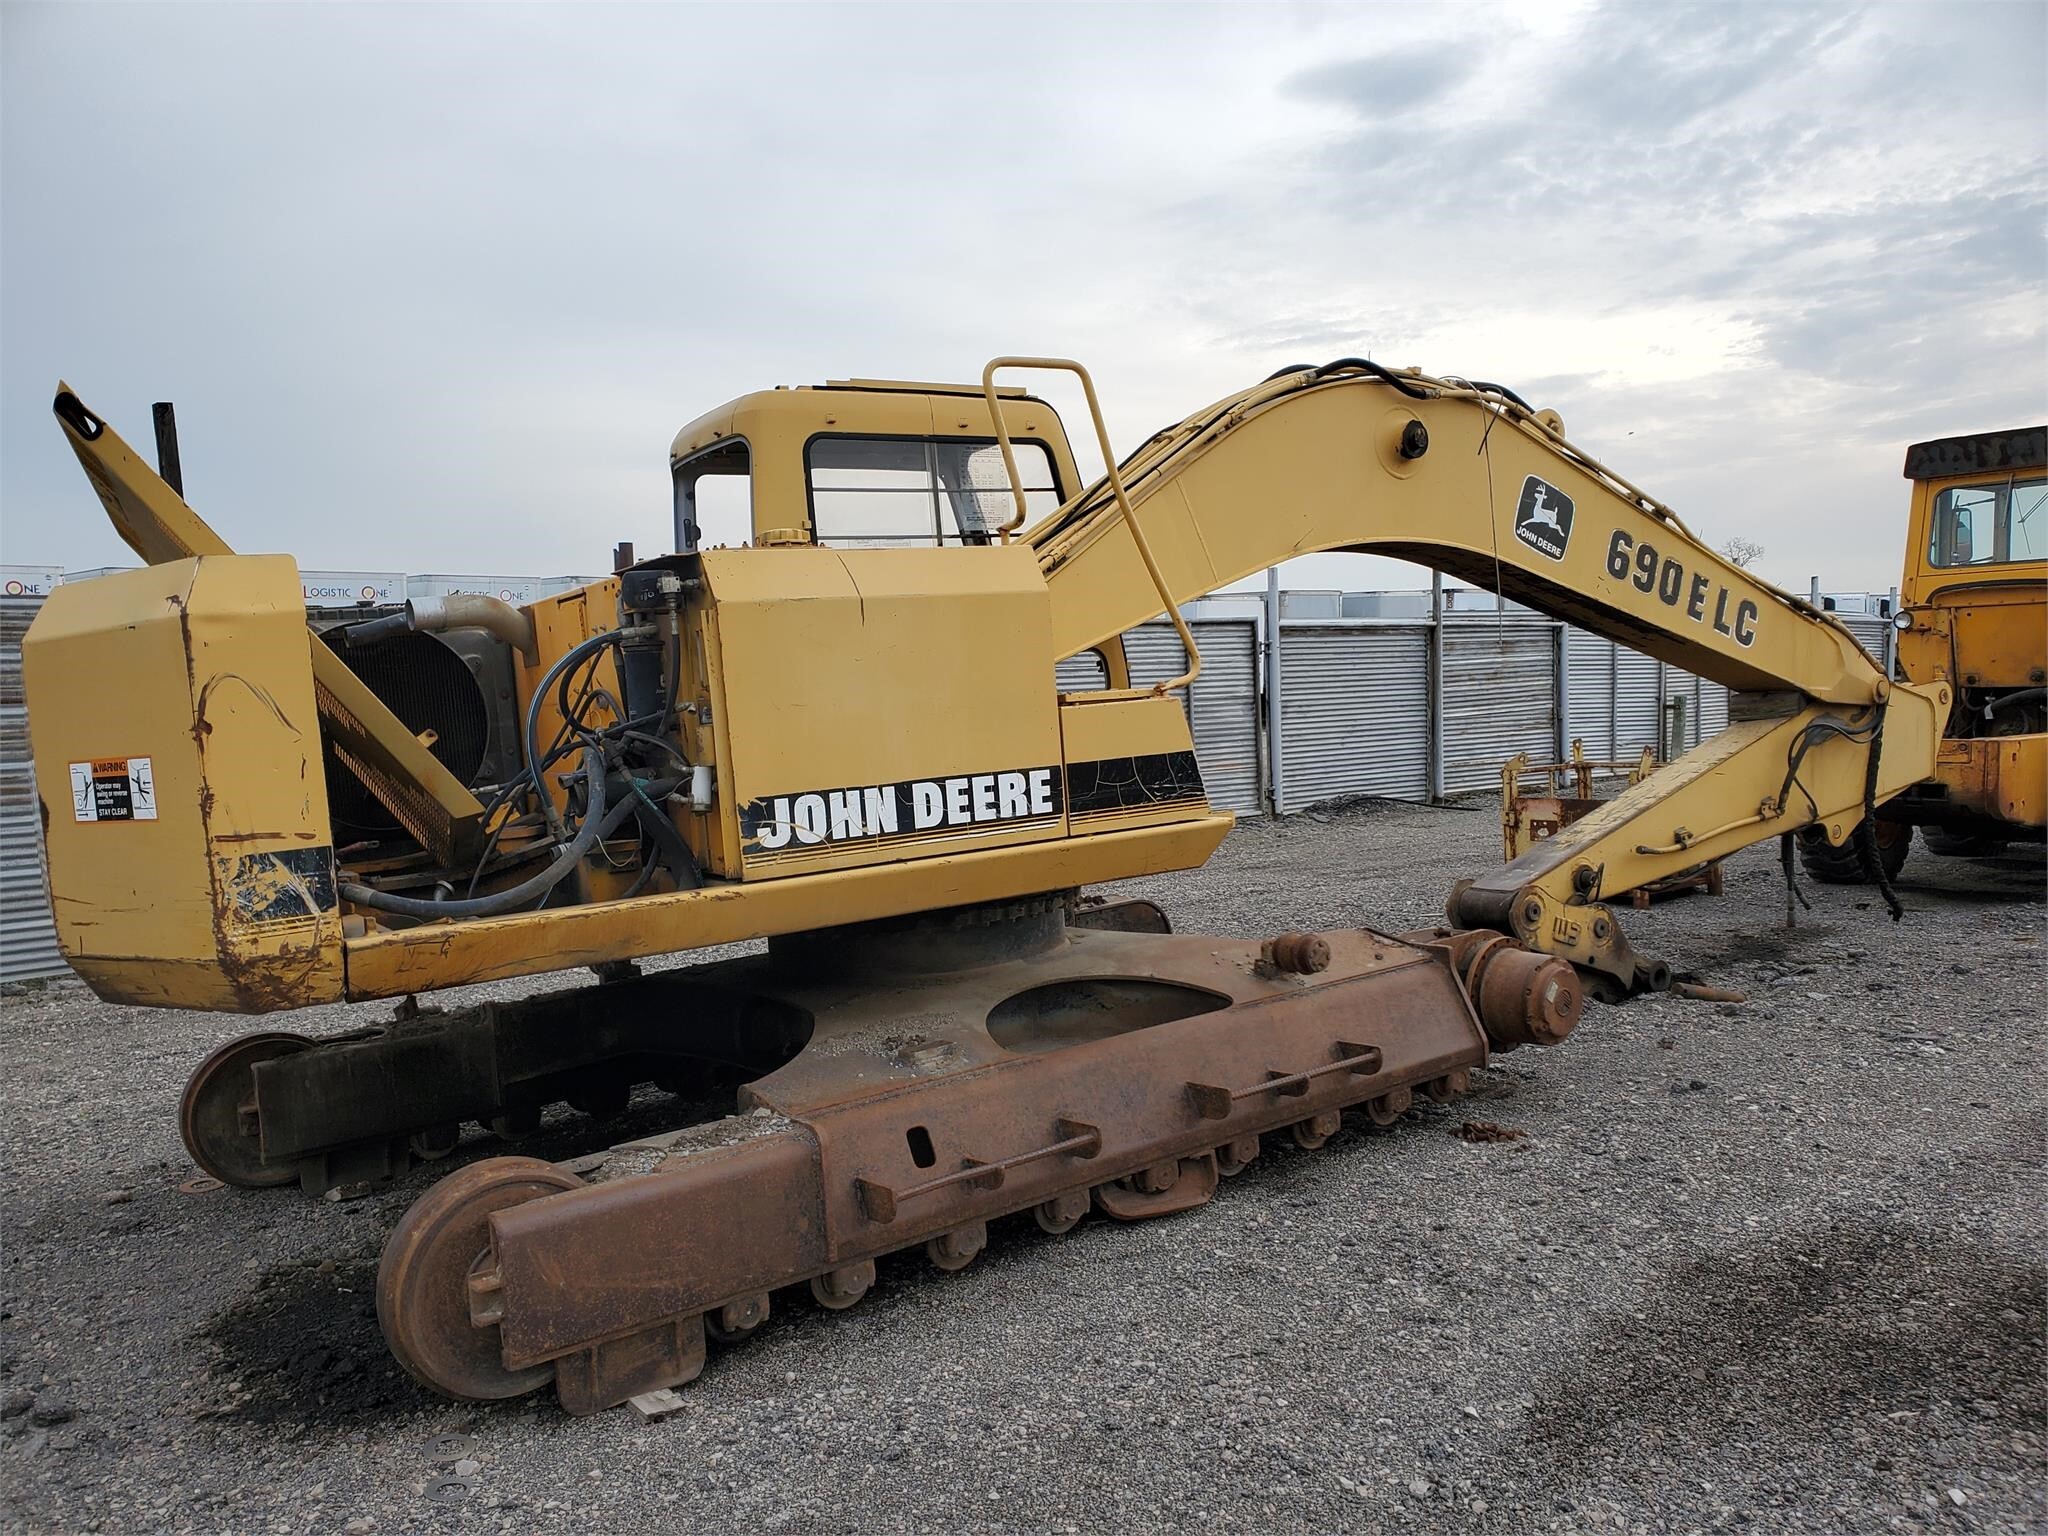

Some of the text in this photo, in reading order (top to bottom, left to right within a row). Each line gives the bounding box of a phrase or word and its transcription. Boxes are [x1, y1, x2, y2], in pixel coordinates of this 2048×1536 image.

[1516, 526, 1562, 556] JOHN DEERE
[6, 581, 40, 596] ONE
[362, 586, 388, 599] ONE
[500, 590, 524, 602] ONE
[98, 761, 126, 773] WARNING
[99, 807, 128, 816] STAY CLEAR
[756, 768, 1053, 849] JOHN DEERE
